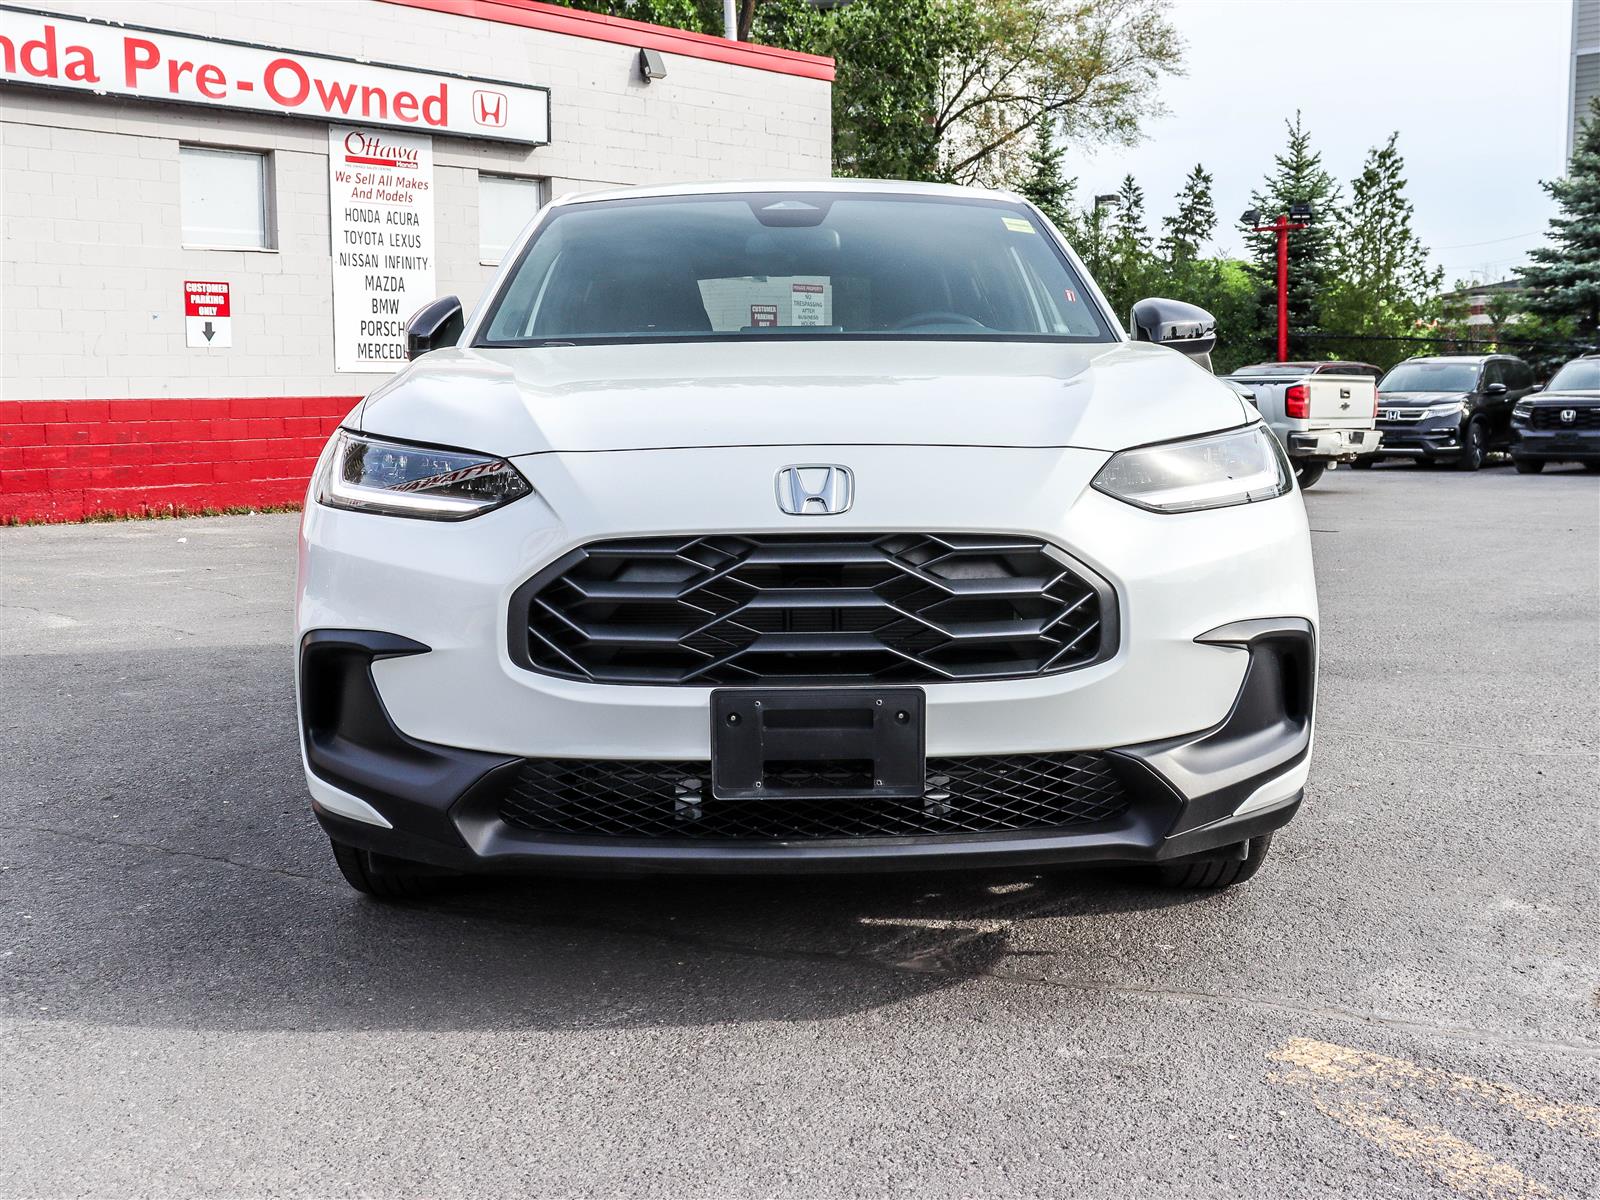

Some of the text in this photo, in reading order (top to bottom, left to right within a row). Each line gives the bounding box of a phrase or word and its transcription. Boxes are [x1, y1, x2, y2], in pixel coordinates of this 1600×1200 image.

[124, 37, 448, 127] Pre-Owned
[344, 131, 418, 161] Ottawa
[396, 160, 418, 169] Honda
[335, 171, 429, 190] We Sell All Makes
[351, 187, 413, 203] And Models
[345, 208, 419, 226] HONDA ACURA
[344, 230, 421, 248] TOYOTA LEXUS
[340, 252, 428, 270] NISSAN INFINITY
[186, 283, 229, 293] CUSTOMER
[365, 275, 405, 292] MAZDA
[190, 294, 225, 305] PARKING
[372, 298, 400, 314] BMW
[794, 300, 823, 308] TRESPASSING
[198, 306, 217, 315] ONLY
